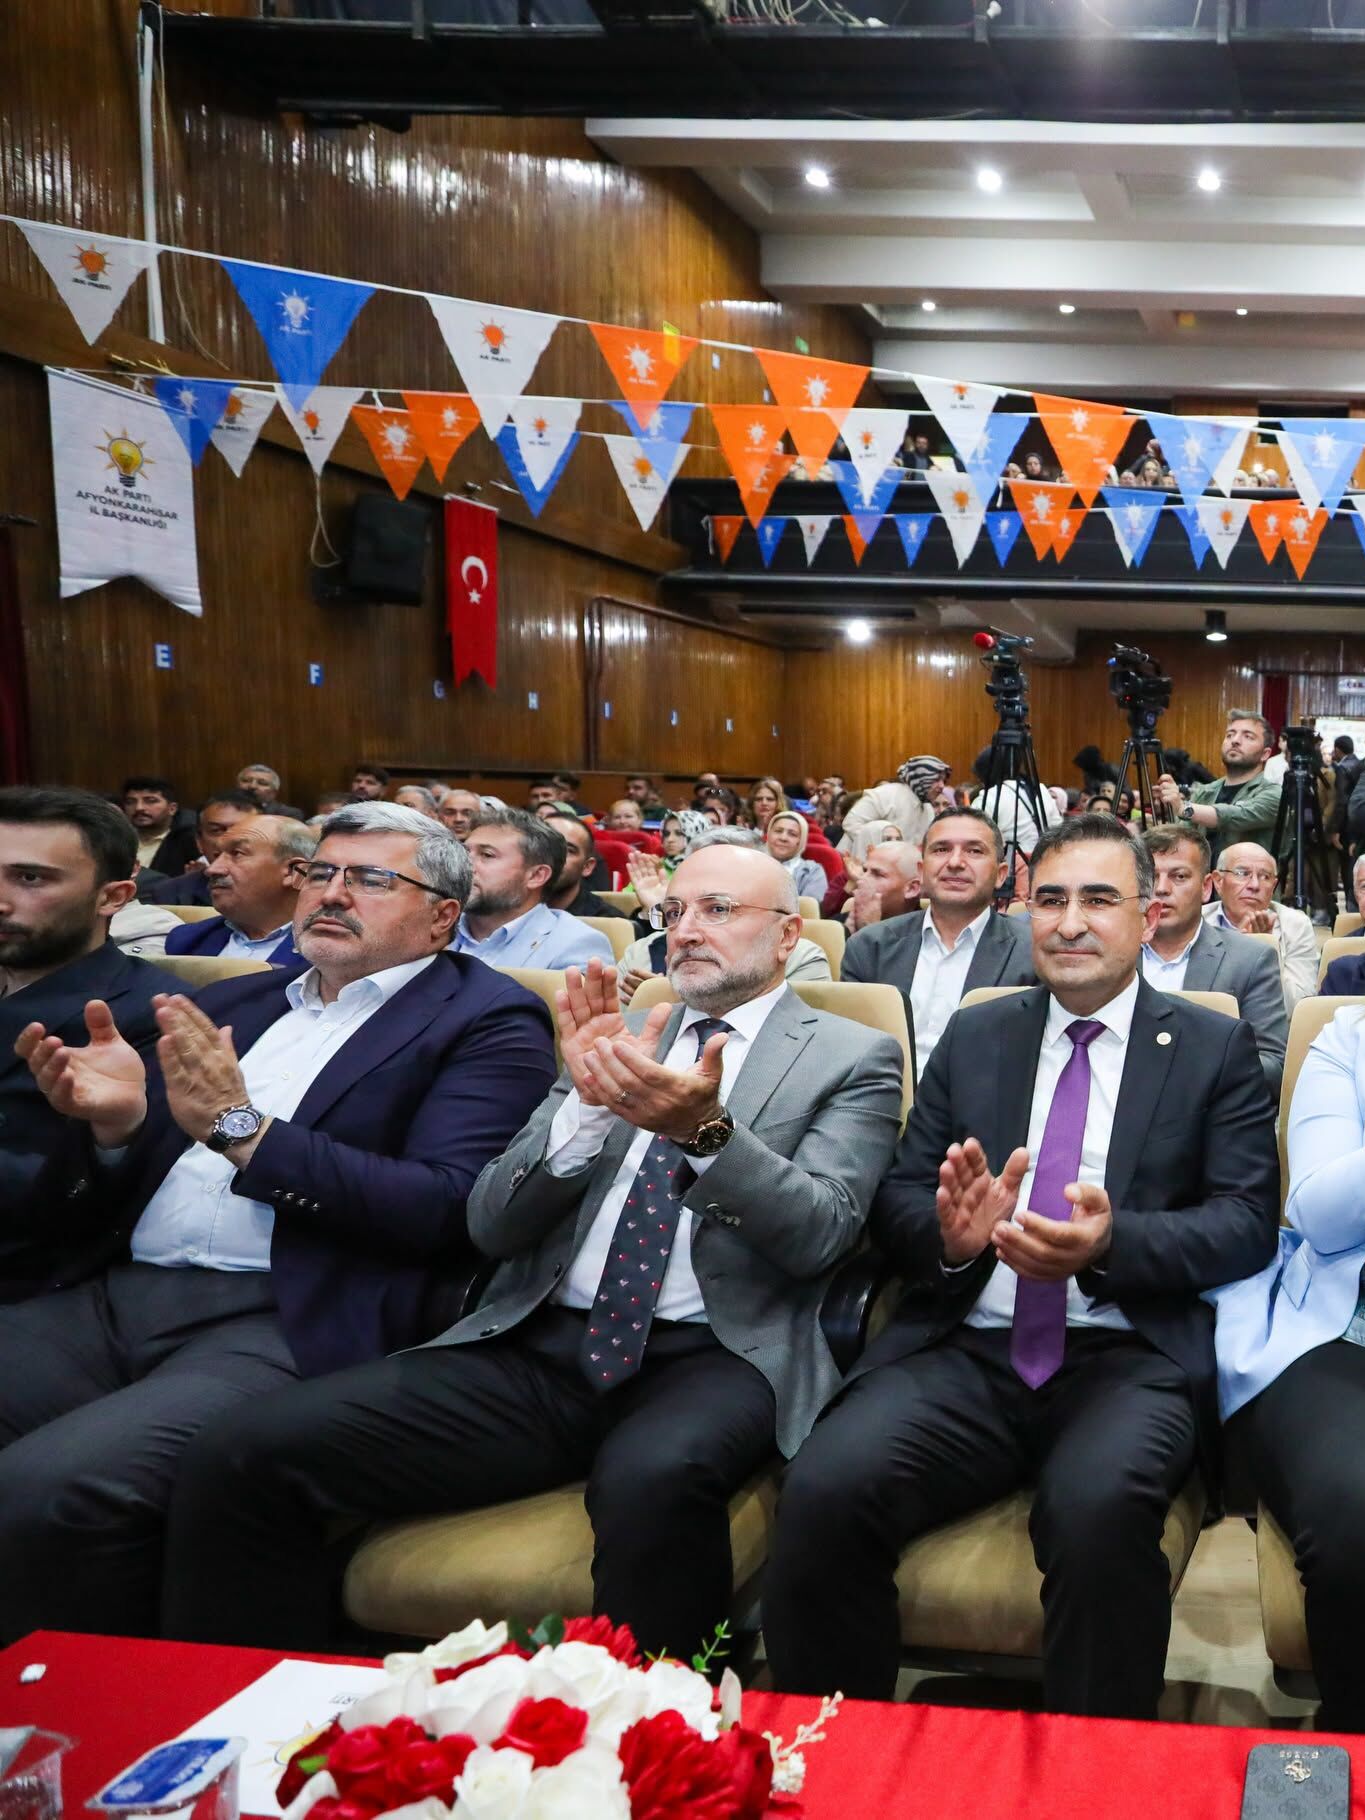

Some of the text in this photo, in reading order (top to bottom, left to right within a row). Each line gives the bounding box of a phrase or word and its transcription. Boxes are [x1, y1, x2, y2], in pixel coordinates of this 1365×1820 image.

[104, 485, 120, 496] AK
[154, 644, 171, 669] E
[309, 663, 320, 685] F
